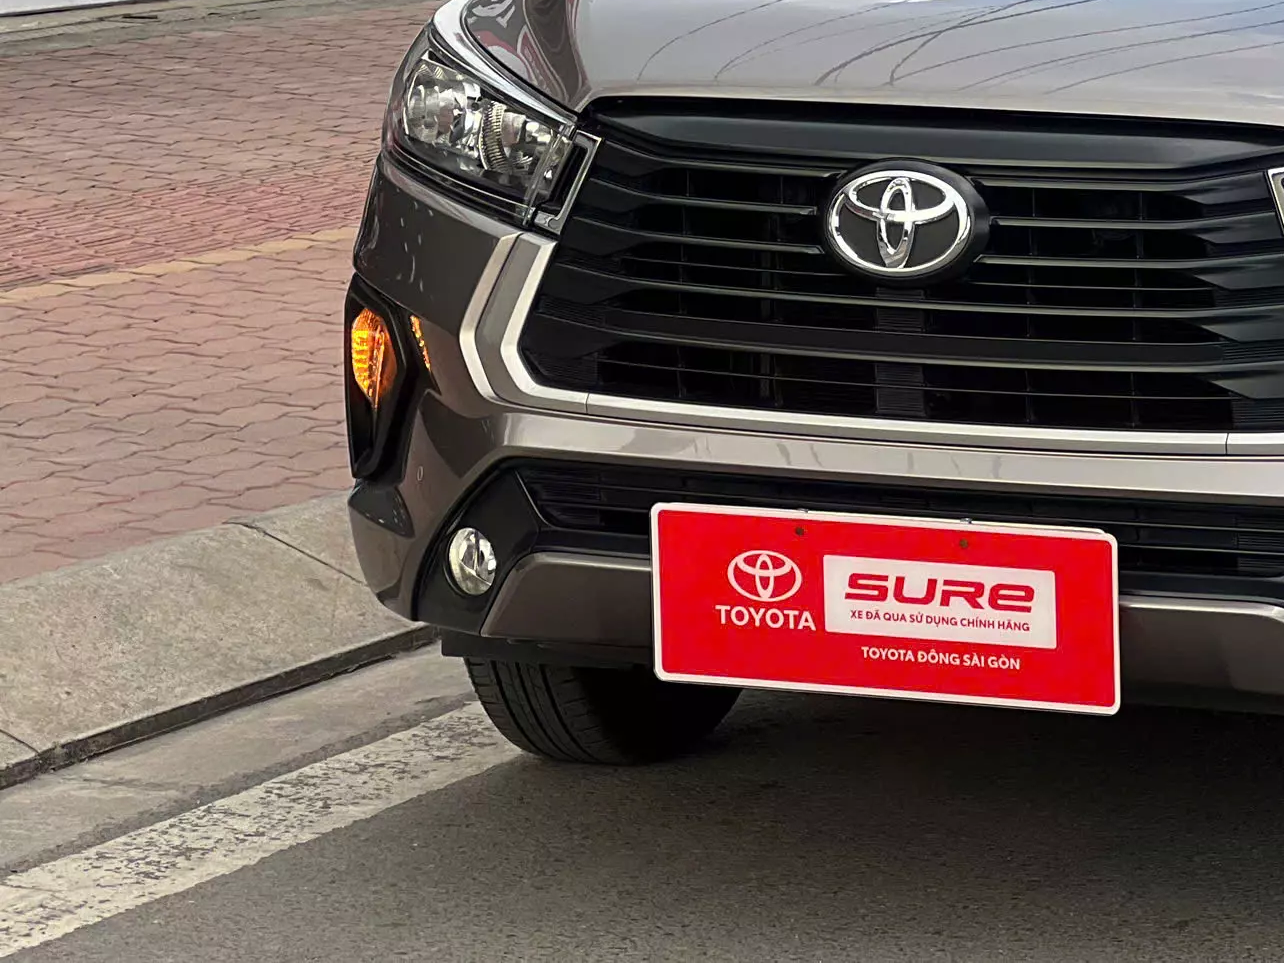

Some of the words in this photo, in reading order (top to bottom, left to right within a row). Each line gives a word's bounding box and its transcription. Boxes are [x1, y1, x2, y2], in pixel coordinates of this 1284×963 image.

[715, 604, 817, 631] TOYOTA
[850, 609, 863, 620] XE
[866, 610, 881, 621] ĐÃ
[883, 612, 907, 623] QUA
[910, 611, 925, 624] SỬ
[926, 615, 958, 628] DỤNG
[960, 616, 995, 630] CHÍNH
[997, 619, 1031, 632] HÃNG
[861, 646, 915, 663] TOYOTA
[917, 648, 960, 666] ĐÔNG
[963, 651, 985, 668] SÀI
[987, 654, 1021, 670] GÒN
